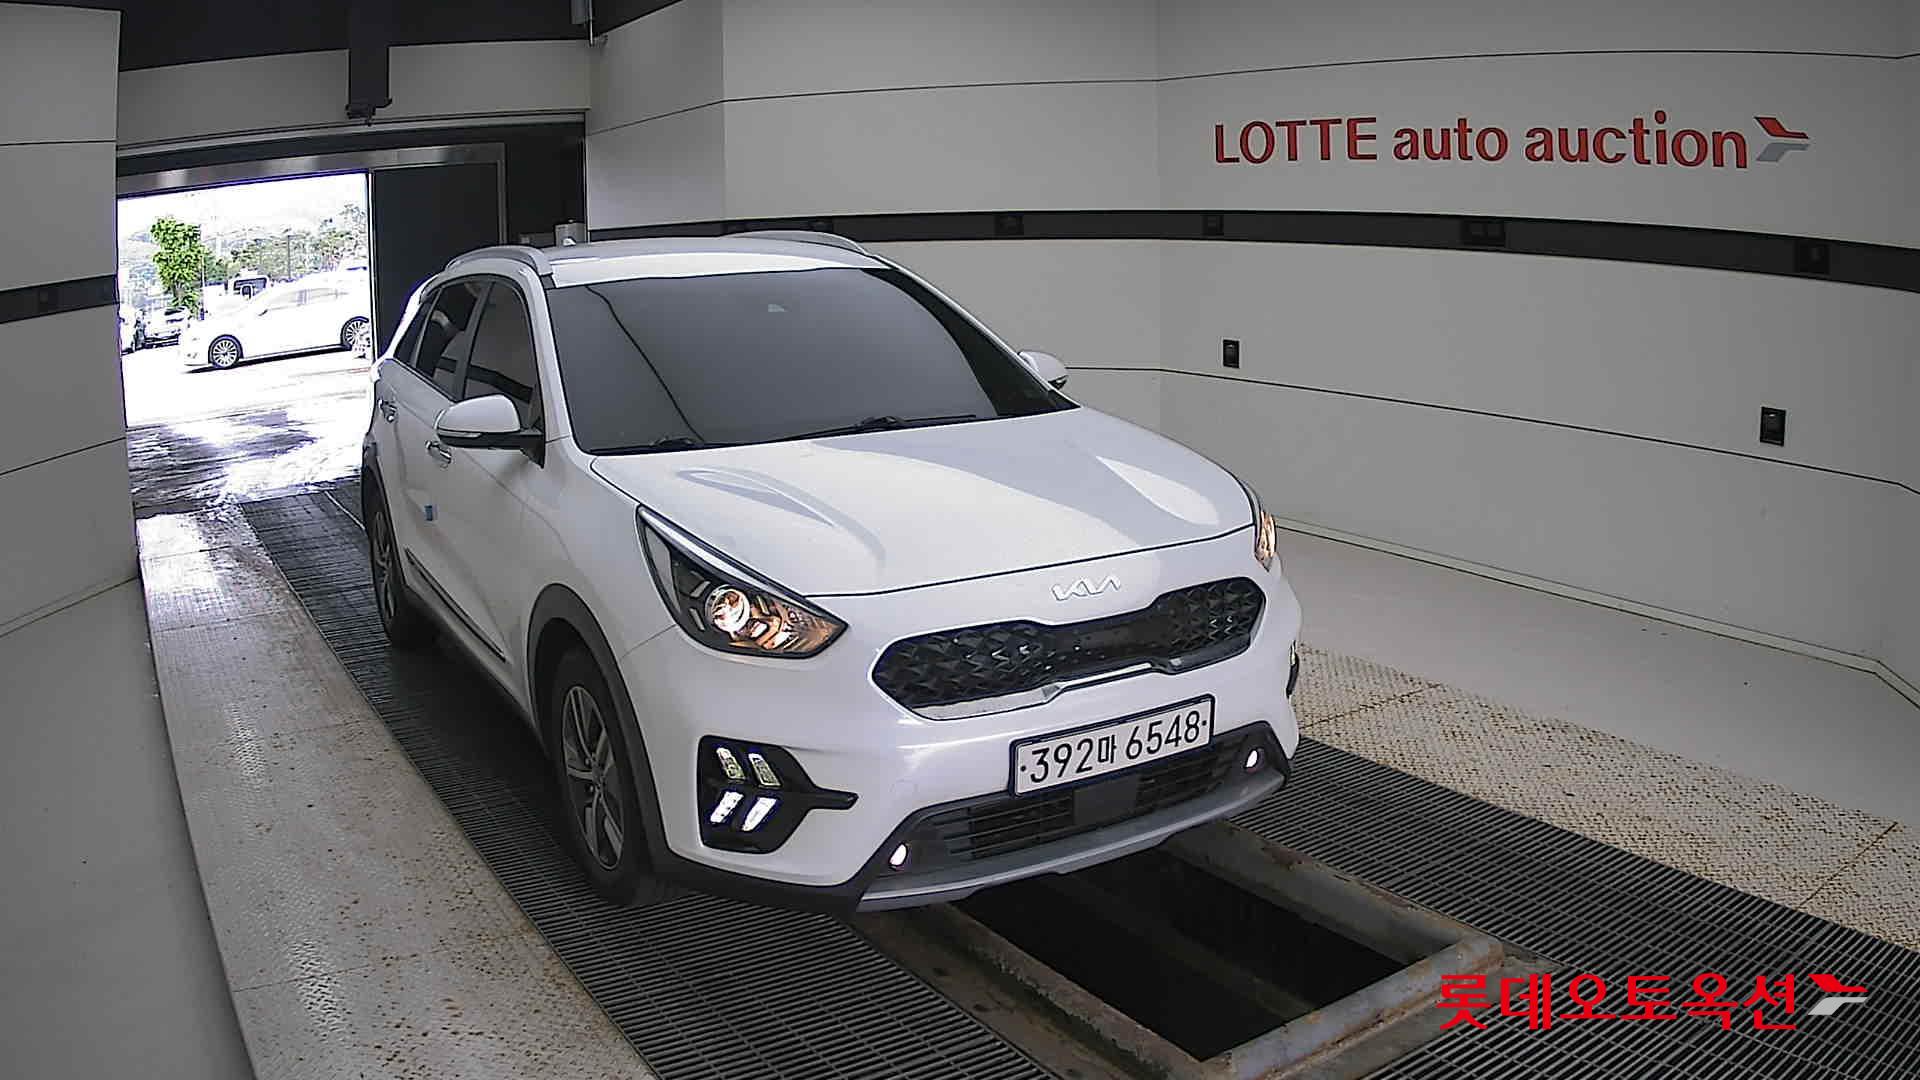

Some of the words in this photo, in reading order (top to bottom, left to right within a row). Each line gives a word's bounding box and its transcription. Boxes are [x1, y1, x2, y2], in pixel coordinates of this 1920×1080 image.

[1214, 117, 1377, 164] LOTTE
[1393, 117, 1507, 162] auto
[1524, 110, 1748, 168] auction
[1030, 734, 1117, 784] 392마
[1126, 710, 1200, 760] 6548
